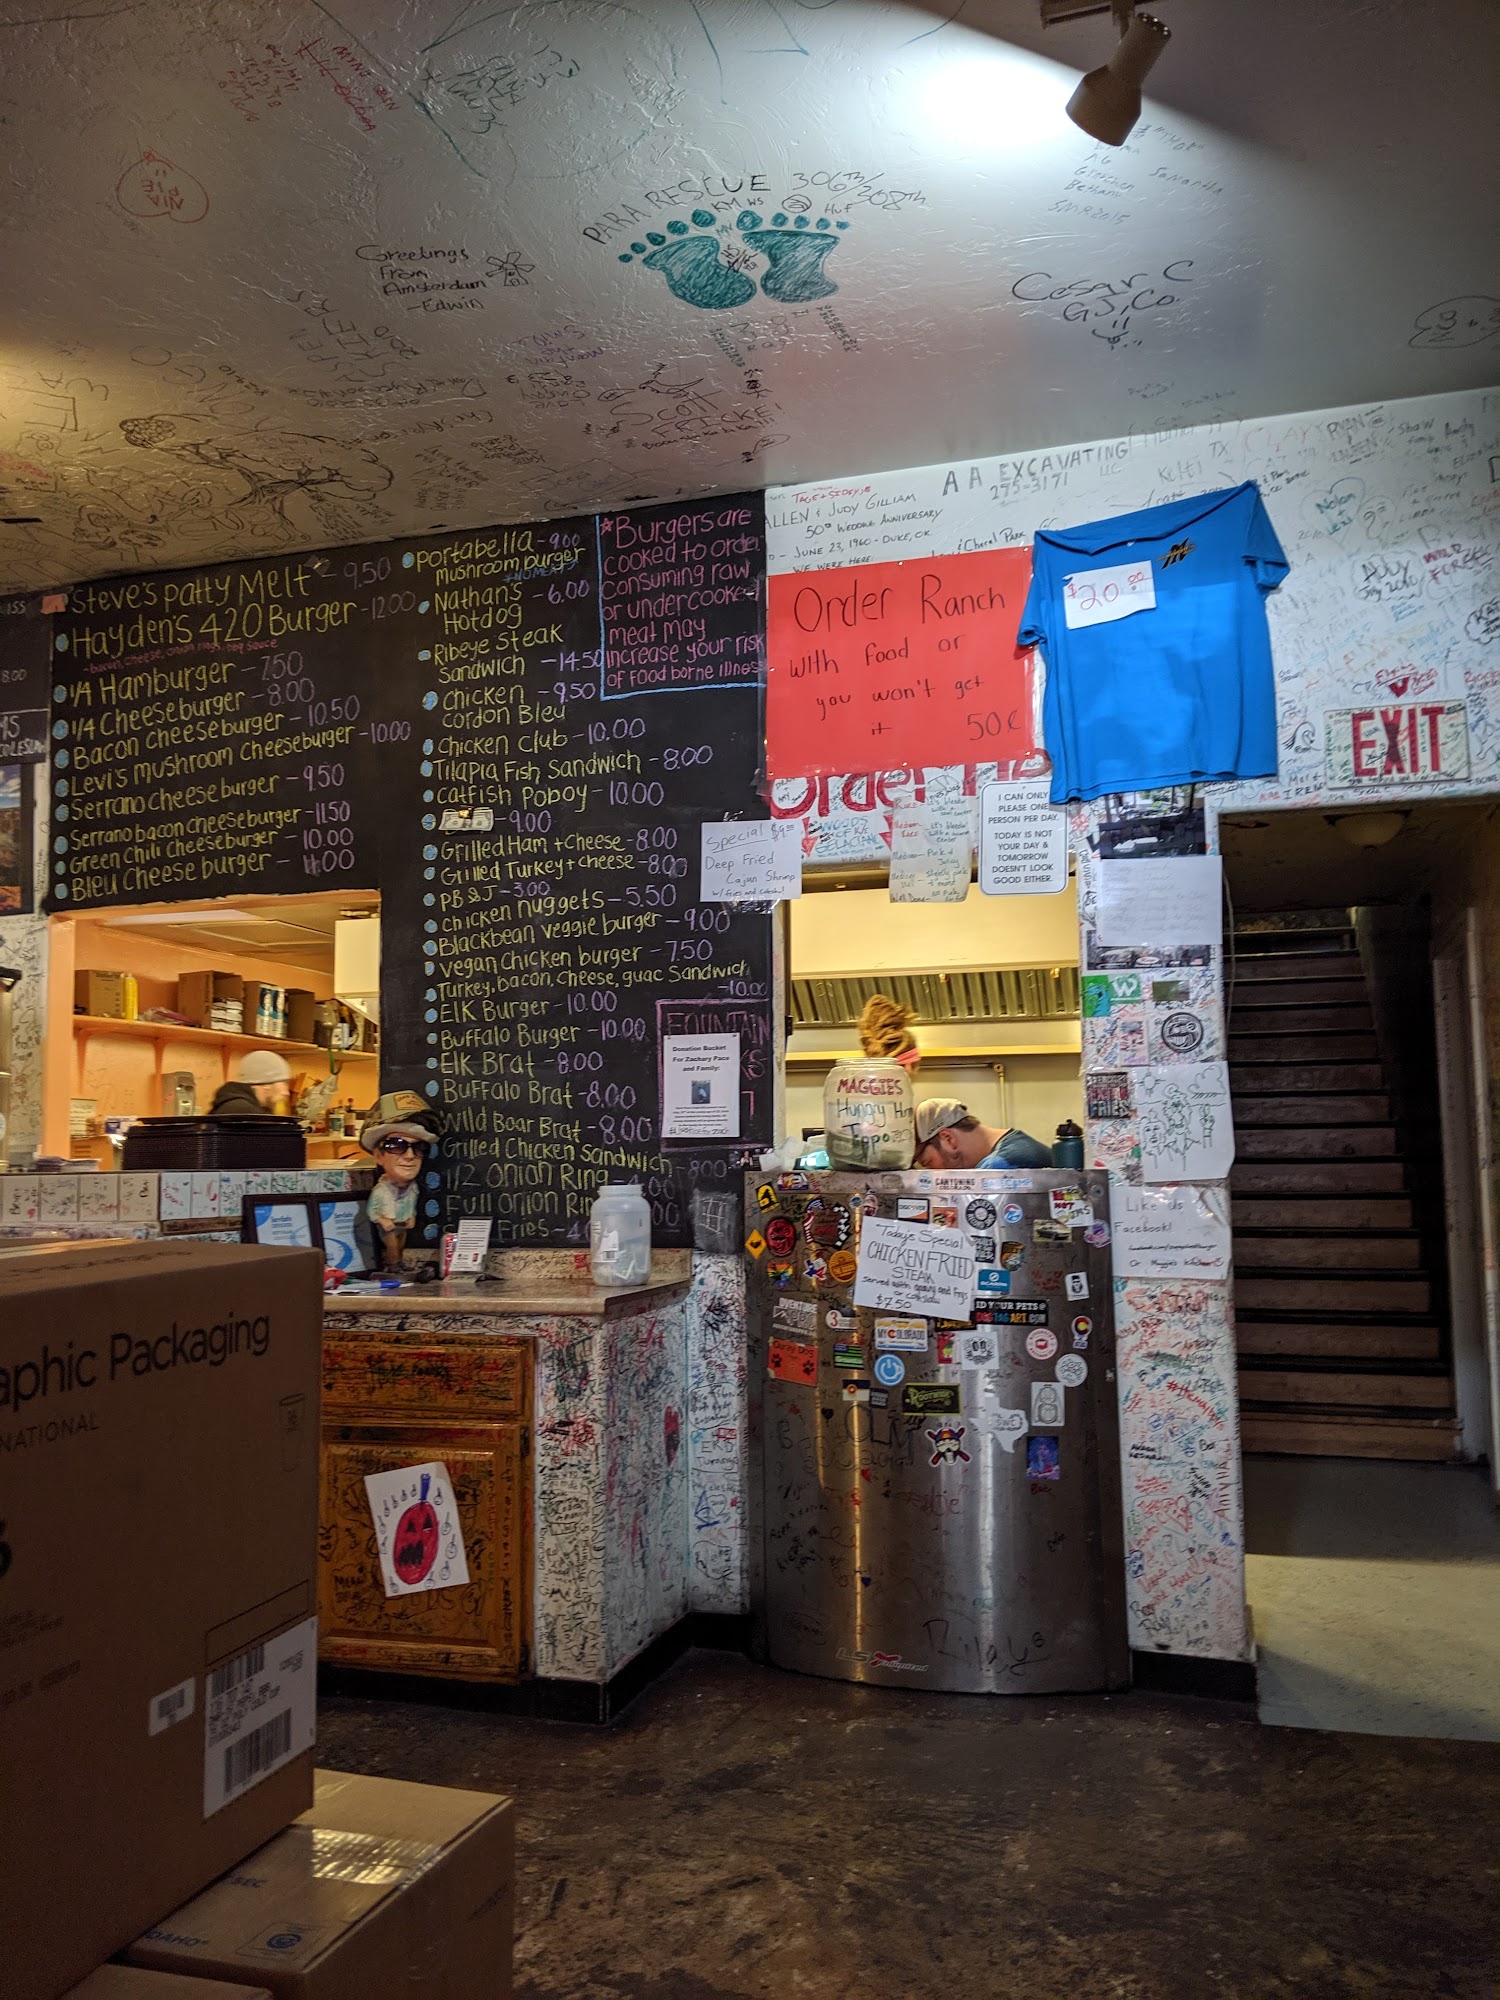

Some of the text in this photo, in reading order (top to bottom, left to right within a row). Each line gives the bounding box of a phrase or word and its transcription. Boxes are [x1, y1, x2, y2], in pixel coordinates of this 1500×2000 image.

[583, 174, 770, 244] PARA RESCUE
[356, 245, 469, 263] Greetings
[383, 279, 487, 296] Amsterdam
[942, 441, 1129, 496] A A EXCAVATING
[717, 509, 752, 527] are
[682, 541, 707, 562] to
[436, 558, 519, 586] mushroom
[72, 582, 157, 614] Steve's
[239, 564, 311, 604] Melt
[435, 582, 523, 614] Nathan's
[794, 574, 1005, 632] Order Ranch
[72, 600, 357, 660] Hayden's 420 Burger
[938, 634, 964, 652] or
[435, 638, 490, 667] Ribeye
[686, 632, 732, 664] your
[100, 661, 237, 698] Hamburger
[438, 655, 525, 684] Sandwich
[817, 676, 984, 721] you won't get
[519, 702, 566, 725] Bleu
[871, 722, 893, 735] it
[1352, 705, 1445, 777] EXIT
[72, 766, 128, 797] Levi's
[134, 746, 233, 784] mushroom
[433, 749, 641, 784] Tilapia Fish Sandwich
[998, 803, 1049, 812] PLEASE ONE
[1004, 792, 1023, 801] CAN
[1027, 791, 1048, 799] ONLY
[988, 815, 1020, 824] PERSON
[440, 835, 547, 862] Grilled Ham
[994, 831, 1022, 839] TODAY
[998, 843, 1020, 851] YOUR
[70, 855, 120, 875] Green
[705, 851, 775, 872] Deep Fried
[992, 864, 1053, 873] DOESN'T LOOK
[998, 853, 1049, 862] TOMORROW
[440, 862, 501, 885] Grilled
[726, 873, 758, 887] Cajun
[993, 876, 1021, 884] GOOD
[72, 876, 118, 901] Bleu
[517, 888, 604, 917] nuggets
[541, 917, 600, 939] veggie
[602, 910, 663, 935] burger
[578, 945, 643, 969] burger
[483, 997, 550, 1024] Burger
[440, 1021, 581, 1050] Buffalo Burger
[482, 1050, 535, 1075] Brat
[444, 1074, 574, 1109] Buffalo Brat
[493, 1113, 582, 1144] Boar Brat
[867, 1240, 975, 1280] CHICKEN FRIED
[891, 1266, 935, 1285] STEAK
[110, 1312, 271, 1381] Packaging
